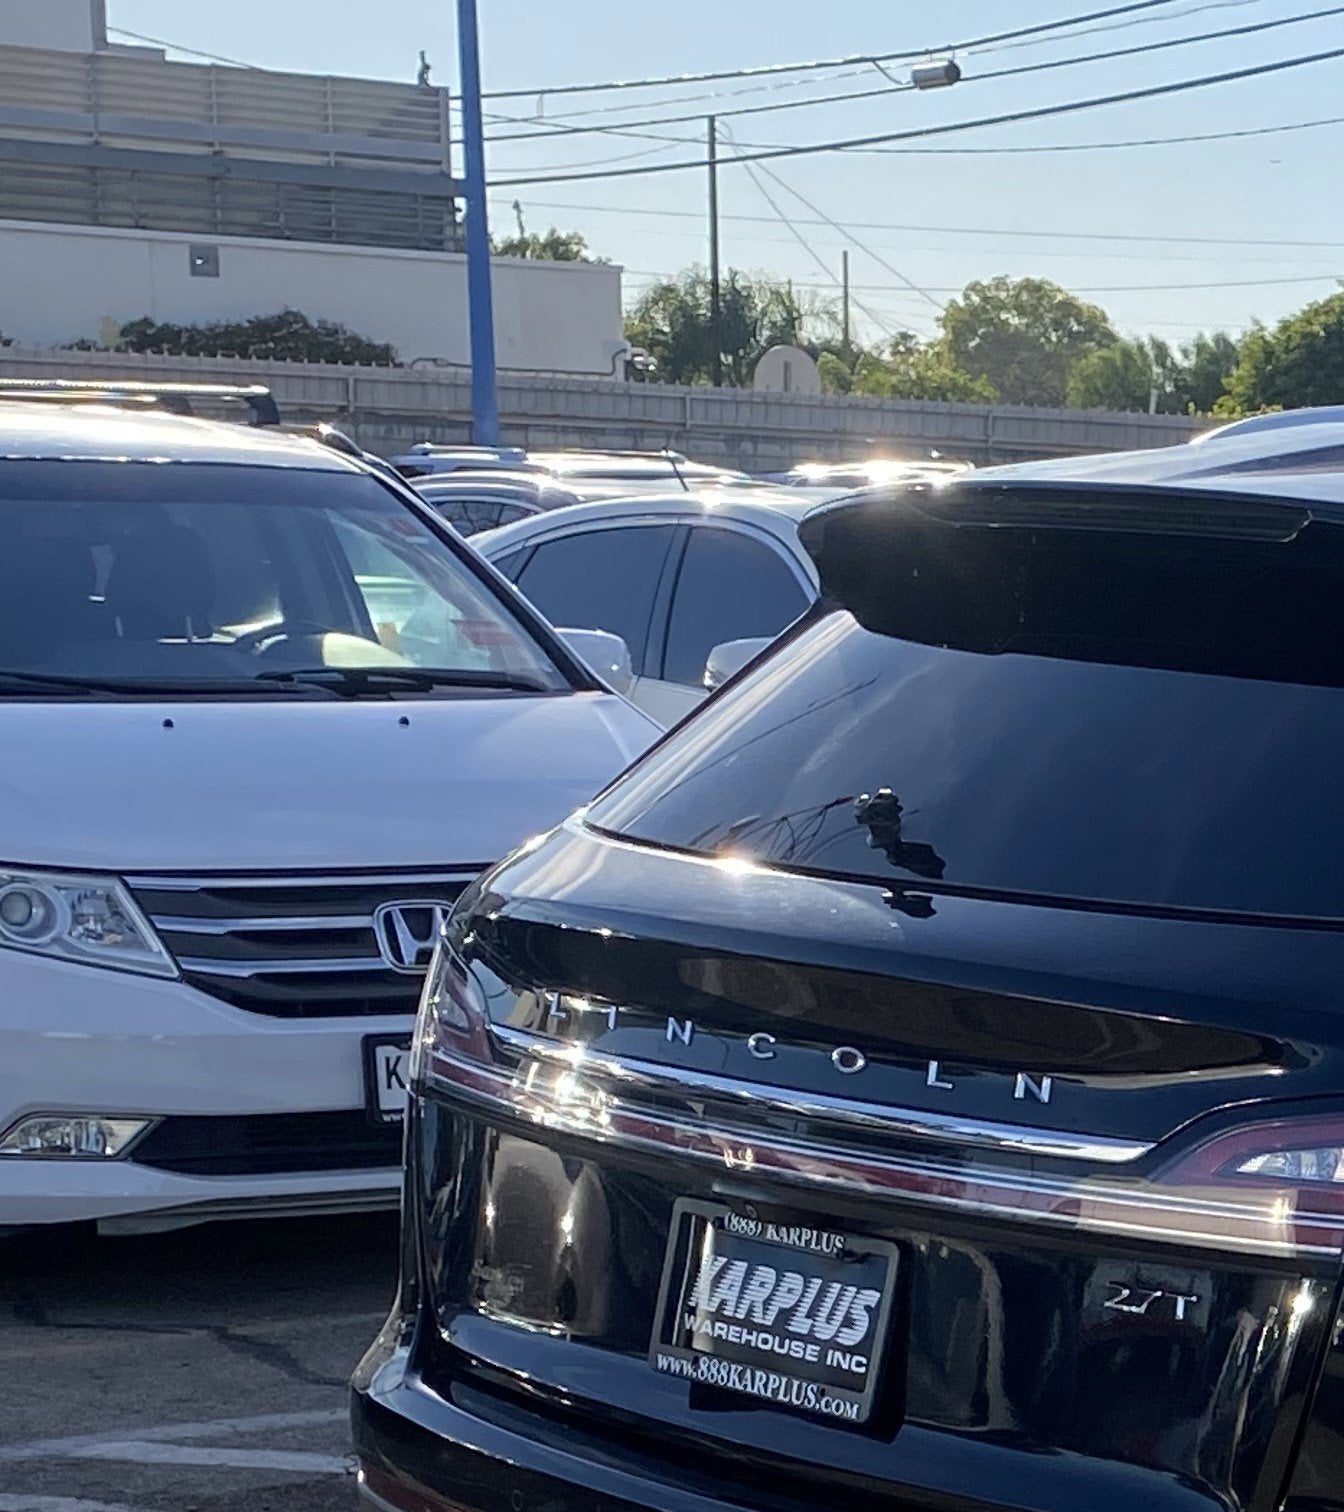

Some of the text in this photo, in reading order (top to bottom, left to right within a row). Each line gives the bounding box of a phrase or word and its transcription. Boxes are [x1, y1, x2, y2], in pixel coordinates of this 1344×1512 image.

[547, 991, 1054, 1105] LINCOLN
[723, 1211, 846, 1255] (888) KARPLUS
[687, 1253, 882, 1347] KARPLUS
[684, 1311, 869, 1375] WAREHOUSE INC
